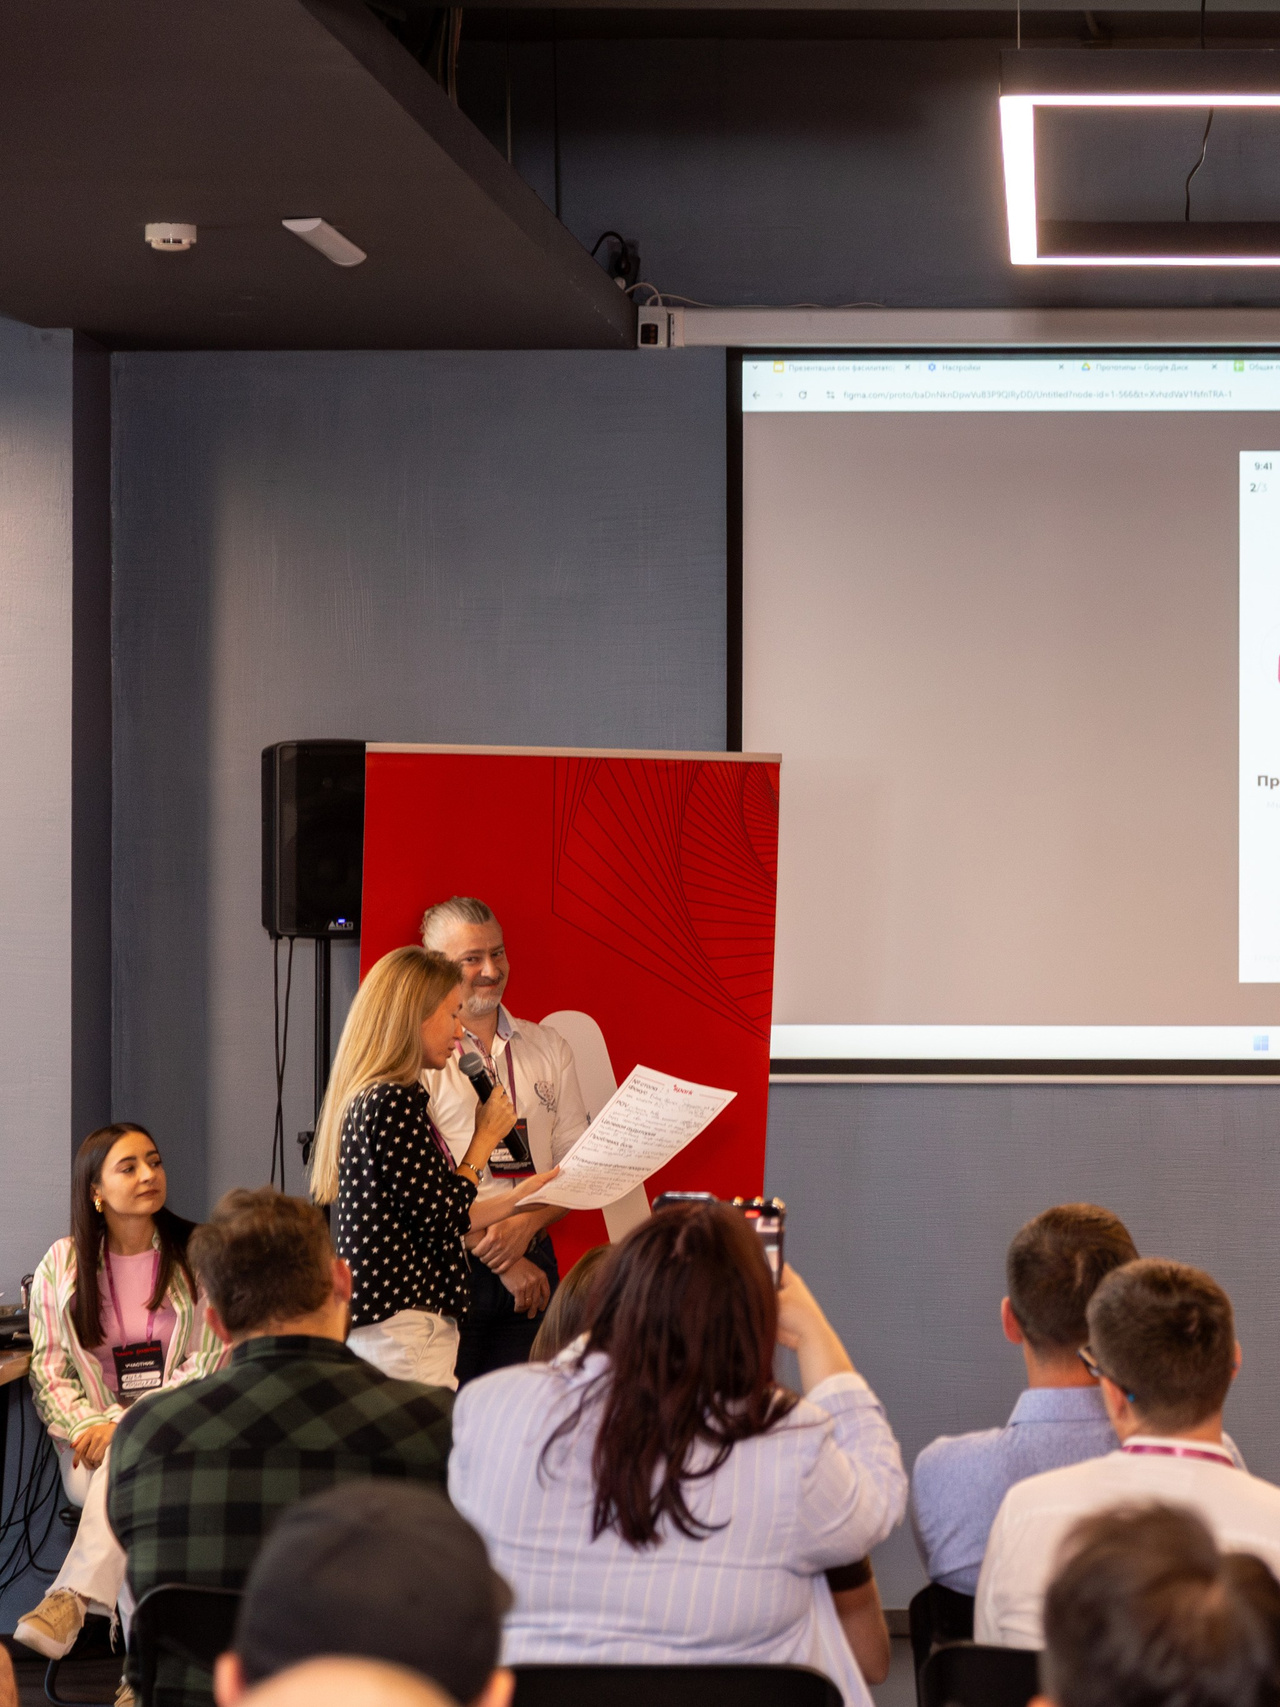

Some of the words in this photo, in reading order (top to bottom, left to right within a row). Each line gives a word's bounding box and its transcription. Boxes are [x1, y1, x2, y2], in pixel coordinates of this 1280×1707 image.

[942, 363, 981, 372] Настройки
[1096, 363, 1137, 373] Прототипы
[1143, 363, 1169, 373] Google
[1171, 363, 1188, 372] Диск
[1254, 461, 1273, 471] 9:41
